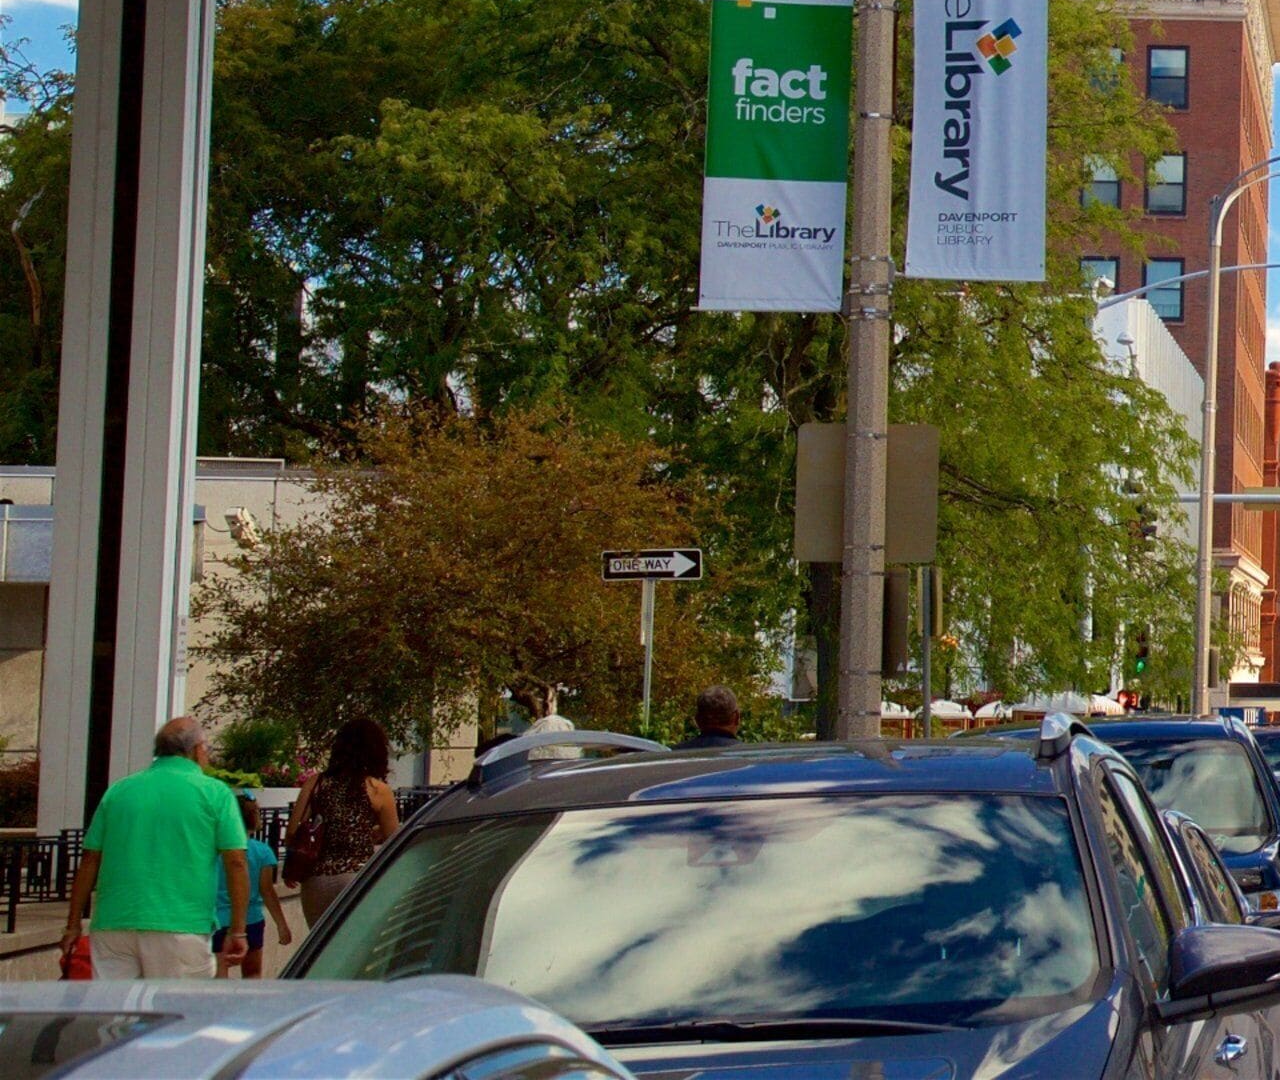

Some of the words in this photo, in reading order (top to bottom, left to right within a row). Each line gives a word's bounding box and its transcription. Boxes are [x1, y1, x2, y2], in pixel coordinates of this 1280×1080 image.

[732, 57, 827, 100] fact
[736, 97, 826, 124] finders
[938, 212, 1018, 222] DAVENPORT
[937, 223, 984, 234] PUBLIC
[717, 241, 767, 249] DAVENPORT
[769, 241, 798, 250] PUBLIC
[936, 235, 993, 246] LIBRARY
[613, 560, 640, 572] ONE
[645, 559, 672, 570] WAY
